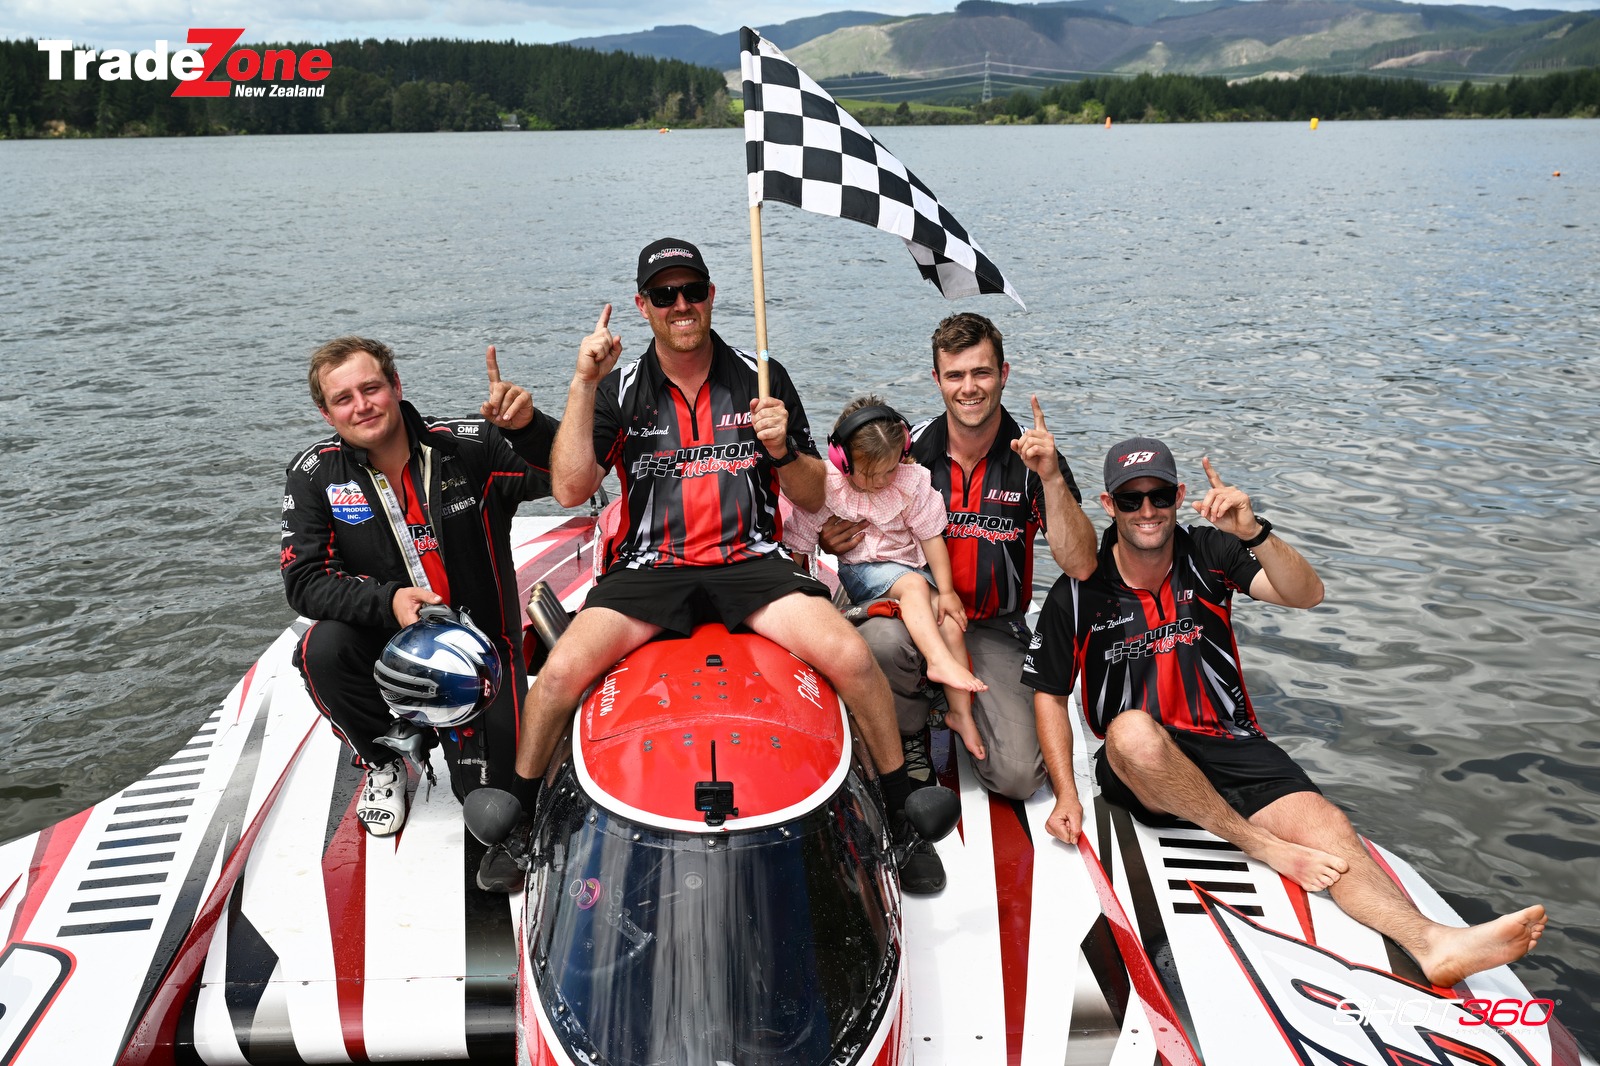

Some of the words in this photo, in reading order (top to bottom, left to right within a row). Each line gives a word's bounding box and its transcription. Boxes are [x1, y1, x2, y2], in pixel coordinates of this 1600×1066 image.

[716, 412, 752, 427] JLM3
[457, 426, 479, 434] OMP
[640, 425, 670, 438] Zealand
[653, 449, 676, 459] JACK
[675, 440, 756, 463] LUPTON
[1122, 450, 1156, 468] 33
[676, 450, 763, 477] Motorsport
[984, 489, 1022, 502] JLM33
[944, 518, 1024, 545] Motorsport
[1091, 623, 1106, 633] New
[1107, 612, 1134, 629] Zealand
[358, 810, 391, 822] OMP
